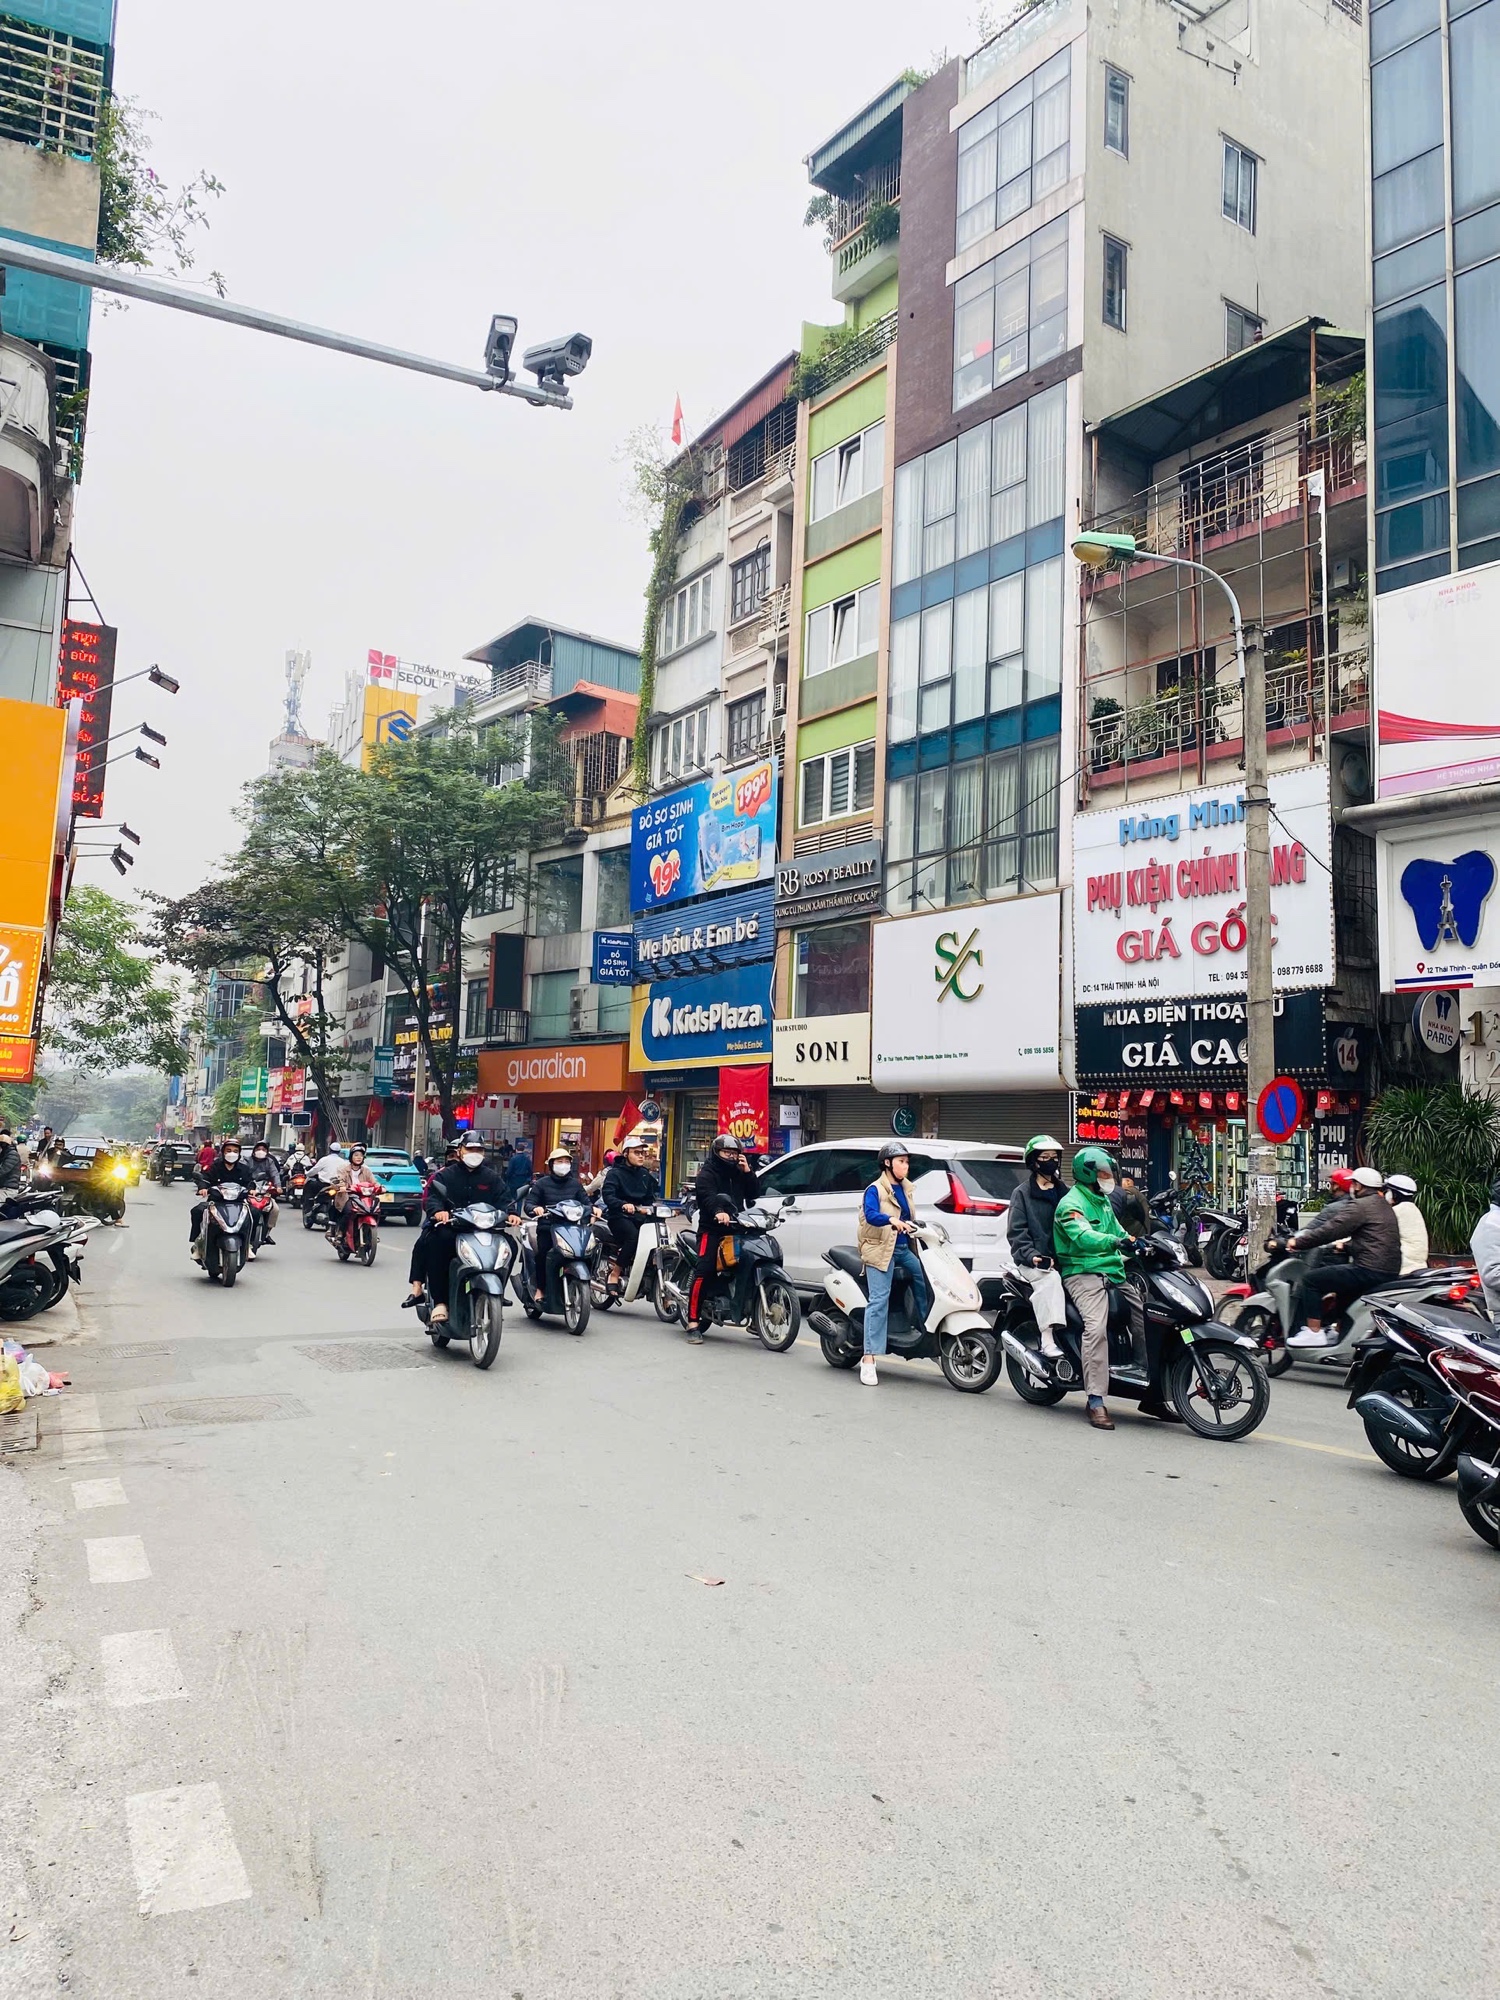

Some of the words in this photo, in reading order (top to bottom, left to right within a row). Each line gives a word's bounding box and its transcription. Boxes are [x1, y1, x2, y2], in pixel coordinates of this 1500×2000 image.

[1439, 588, 1454, 596] NHA
[1456, 581, 1477, 592] KHOA
[399, 672, 439, 689] SEOUL
[639, 806, 653, 831] ĐỒ
[654, 808, 668, 825] SƠ
[670, 798, 694, 820] SINH
[1119, 813, 1181, 846] Hùng
[1189, 795, 1247, 831] Minh
[646, 828, 662, 850] GIÁ
[665, 820, 684, 844] TỐT
[652, 859, 680, 897] 19K
[778, 868, 799, 896] RB
[803, 869, 830, 886] ROSY
[834, 860, 873, 880] BEAUTY
[1087, 871, 1123, 919] PHỤ
[1126, 858, 1173, 914] KIỆN
[1176, 846, 1240, 899] CHÍNH
[639, 939, 660, 964] Mẹ
[662, 927, 691, 956] bầu
[692, 928, 704, 950] &
[706, 924, 733, 947] Em
[736, 912, 760, 942] bé
[1116, 917, 1181, 963] GIÁ
[600, 967, 614, 976] GIÁ
[615, 966, 630, 977] TỐT
[1226, 972, 1238, 981] 094
[1306, 964, 1324, 974] 6688
[1450, 965, 1466, 973] Thịnh
[1472, 963, 1488, 971] quận
[1094, 984, 1100, 992] 14
[1101, 981, 1114, 991] THÁI
[1116, 981, 1134, 991] THỊNH
[1138, 978, 1146, 988] HÀ
[1149, 977, 1159, 989] NỘI
[672, 1002, 764, 1035] KidsPlaza
[1104, 1008, 1140, 1026] MUA
[1144, 1001, 1187, 1027] ĐIỆN
[1192, 1003, 1249, 1024] THOẠ
[789, 1024, 808, 1032] STUDIO
[1428, 1020, 1439, 1029] NHA
[1440, 1025, 1454, 1034] KHOA
[748, 1041, 756, 1049] Em
[756, 1040, 763, 1049] bé
[1427, 1030, 1453, 1047] PARIS
[796, 1041, 849, 1063] SONI
[1122, 1033, 1183, 1068] GIÁ
[1339, 1044, 1356, 1065] 14
[508, 1052, 586, 1087] guardian
[729, 1119, 759, 1138] 100%
[1078, 1121, 1097, 1139] GIÁ
[1098, 1125, 1119, 1140] CAO
[1124, 1125, 1146, 1140] Chuyên
[1320, 1126, 1345, 1147] PHỤ
[1122, 1144, 1131, 1159] SỬA
[1132, 1146, 1144, 1159] CHỮA
